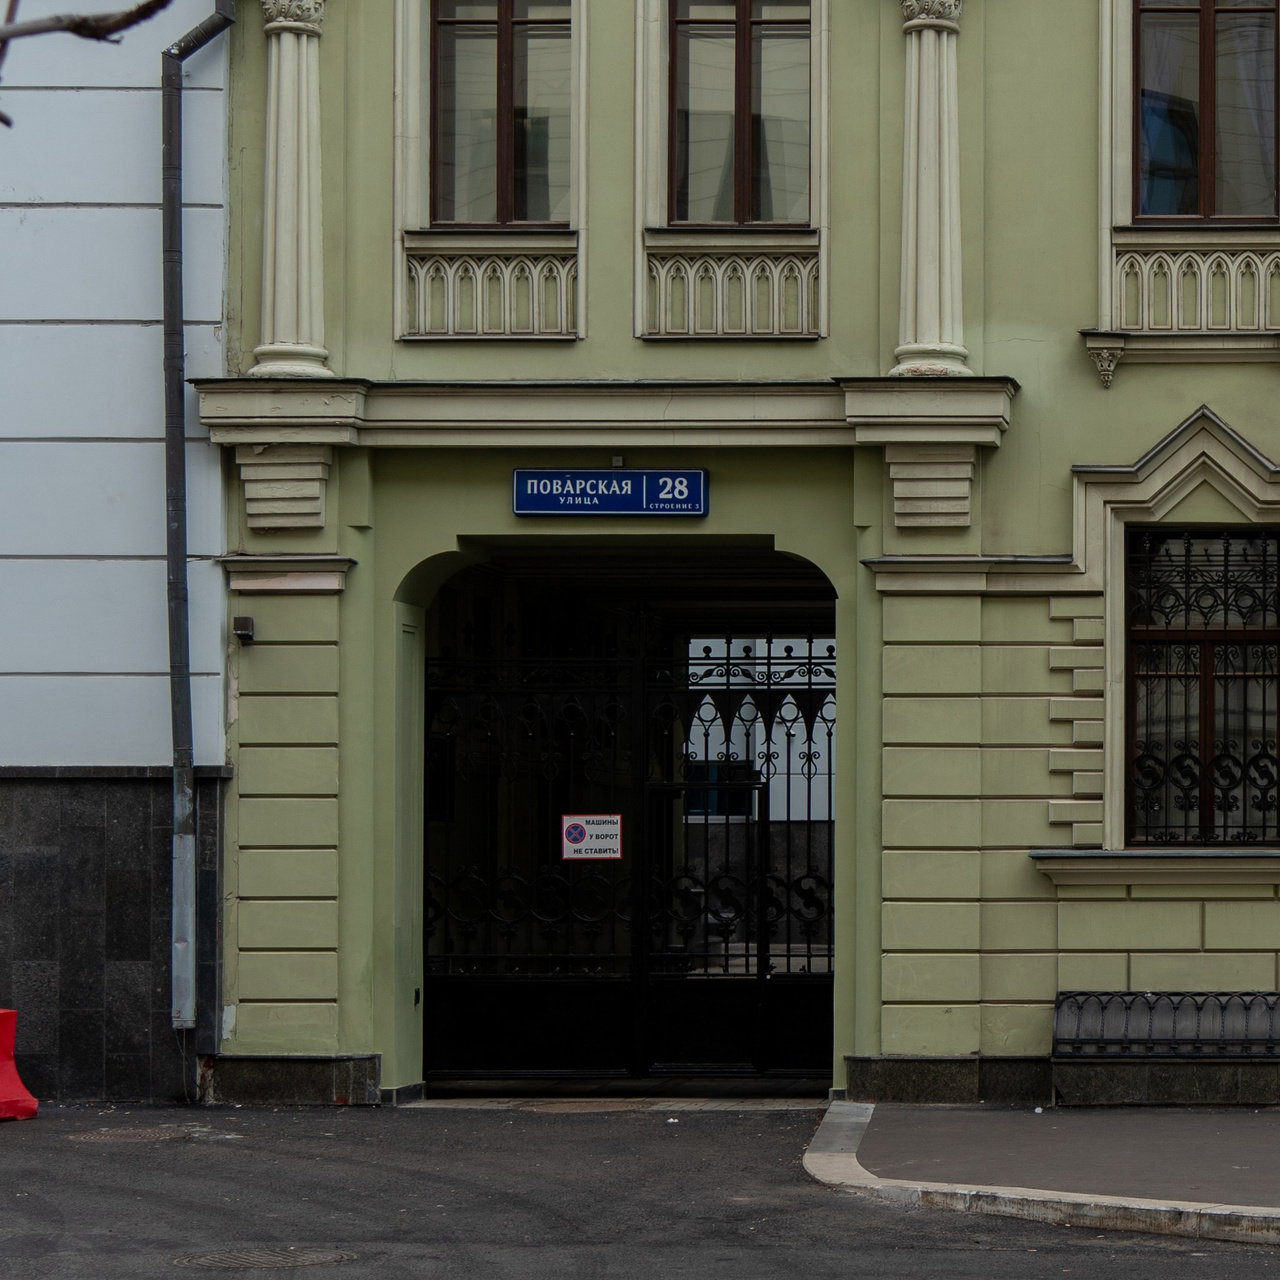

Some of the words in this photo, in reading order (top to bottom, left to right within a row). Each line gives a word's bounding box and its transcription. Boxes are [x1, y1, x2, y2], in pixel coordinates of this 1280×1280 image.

[527, 479, 632, 495] ПОВАРСКАЯ
[658, 477, 689, 499] 28
[559, 496, 599, 505] УЛИЦА
